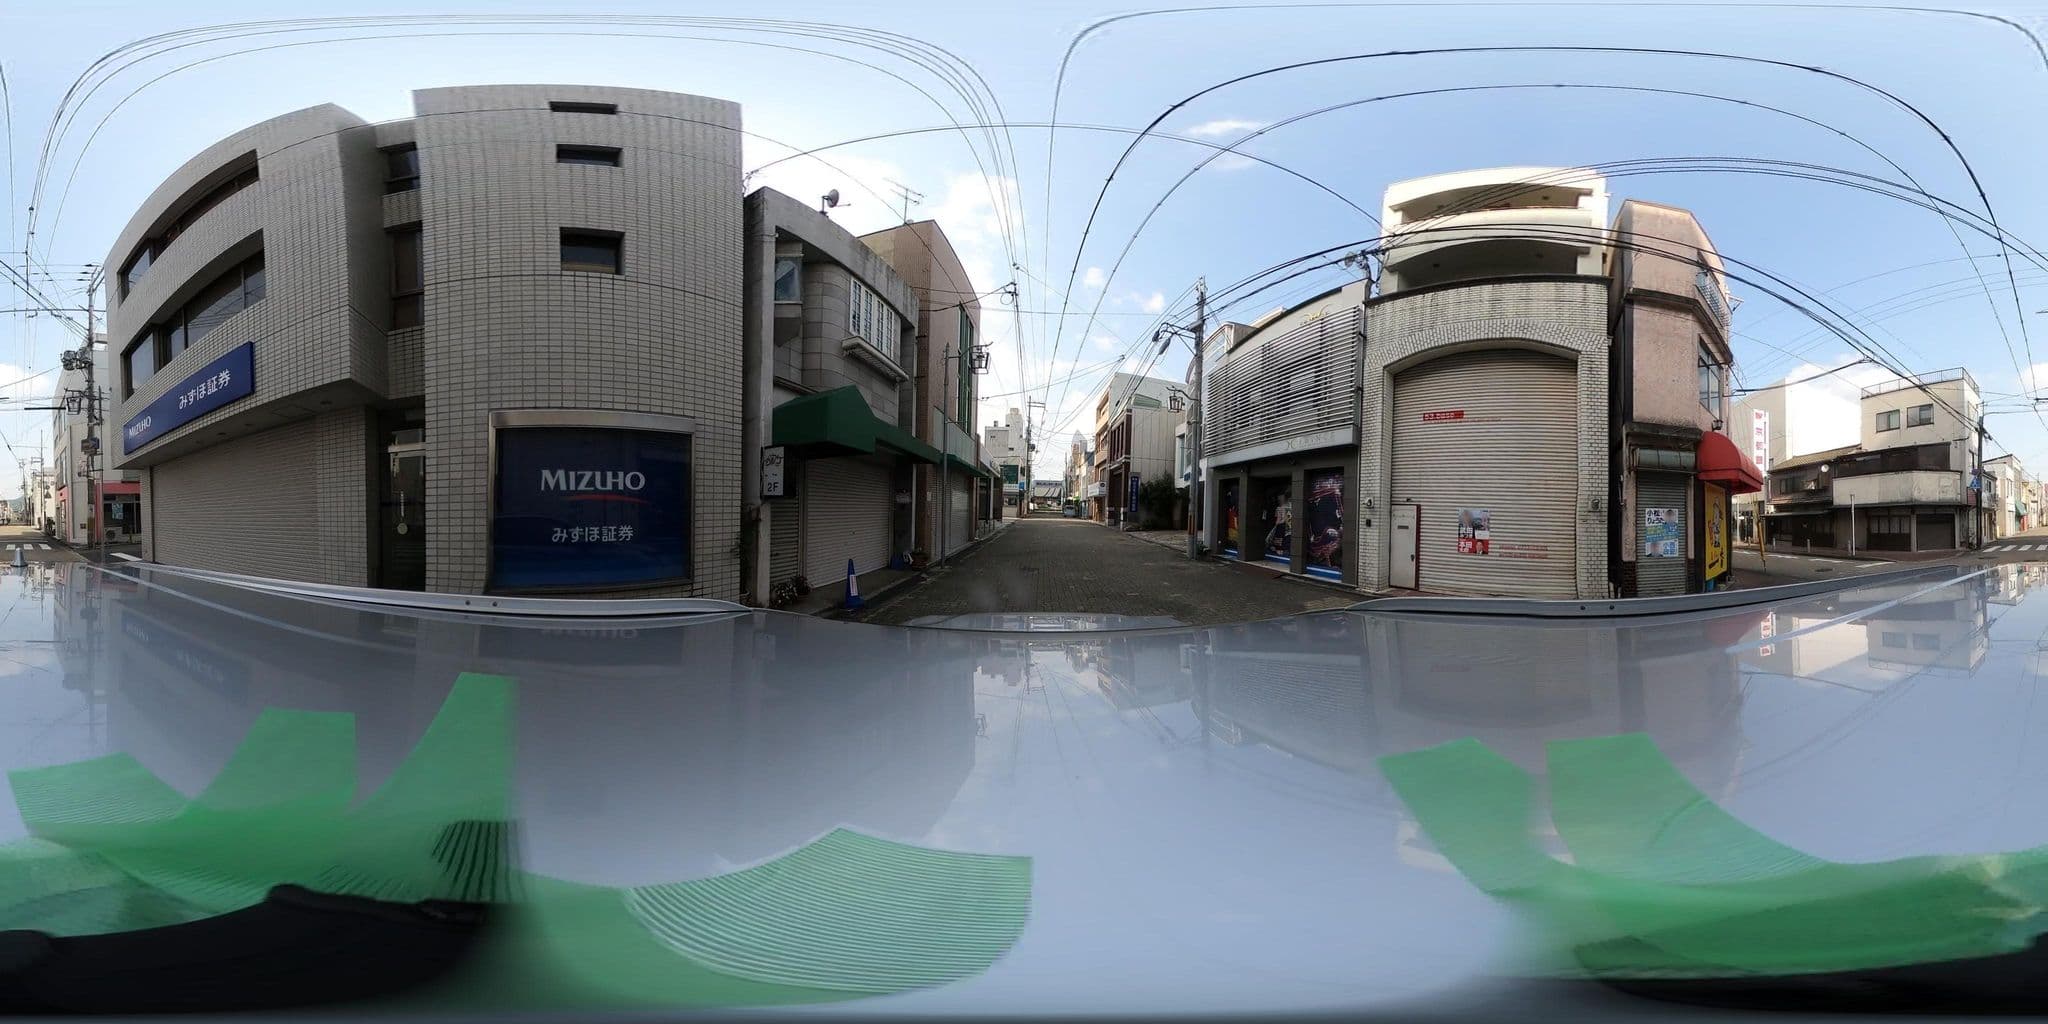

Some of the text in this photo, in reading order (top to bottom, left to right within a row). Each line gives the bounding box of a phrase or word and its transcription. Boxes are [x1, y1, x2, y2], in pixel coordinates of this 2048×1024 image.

[179, 368, 231, 410] みずほ証券
[128, 415, 152, 438] MIZUHO
[541, 468, 646, 491] MIZUHO
[767, 481, 780, 493] 2F
[551, 524, 634, 543] みずほ証券
